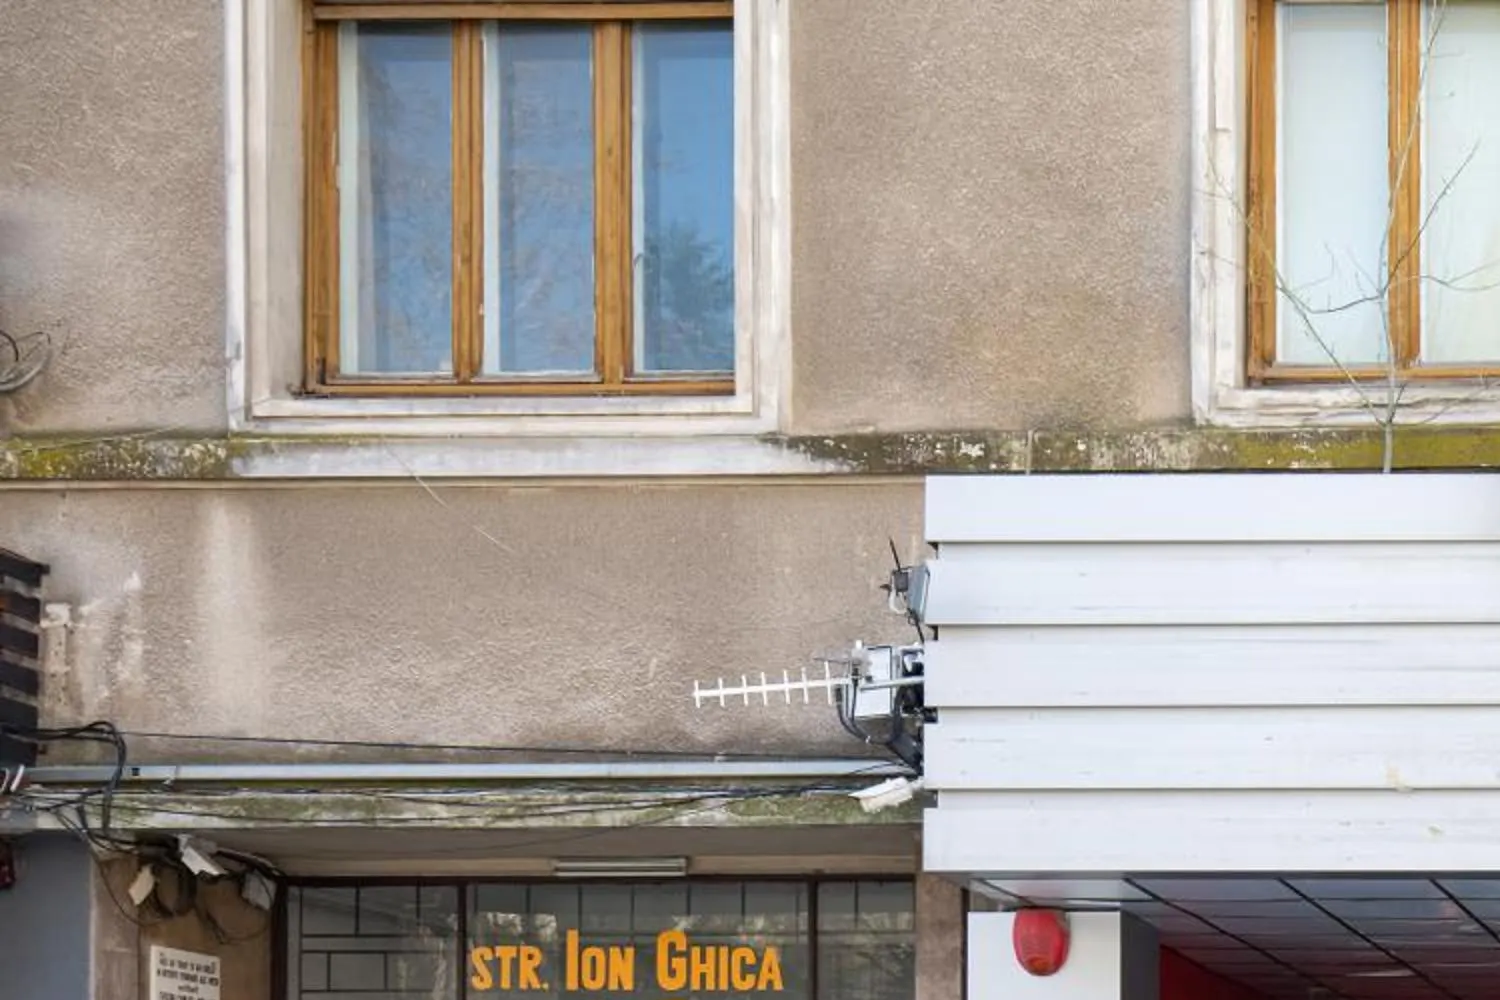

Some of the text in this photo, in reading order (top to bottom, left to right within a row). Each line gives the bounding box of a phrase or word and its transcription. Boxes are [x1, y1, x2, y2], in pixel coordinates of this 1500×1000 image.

[470, 928, 784, 992] STR. ION GHICA
